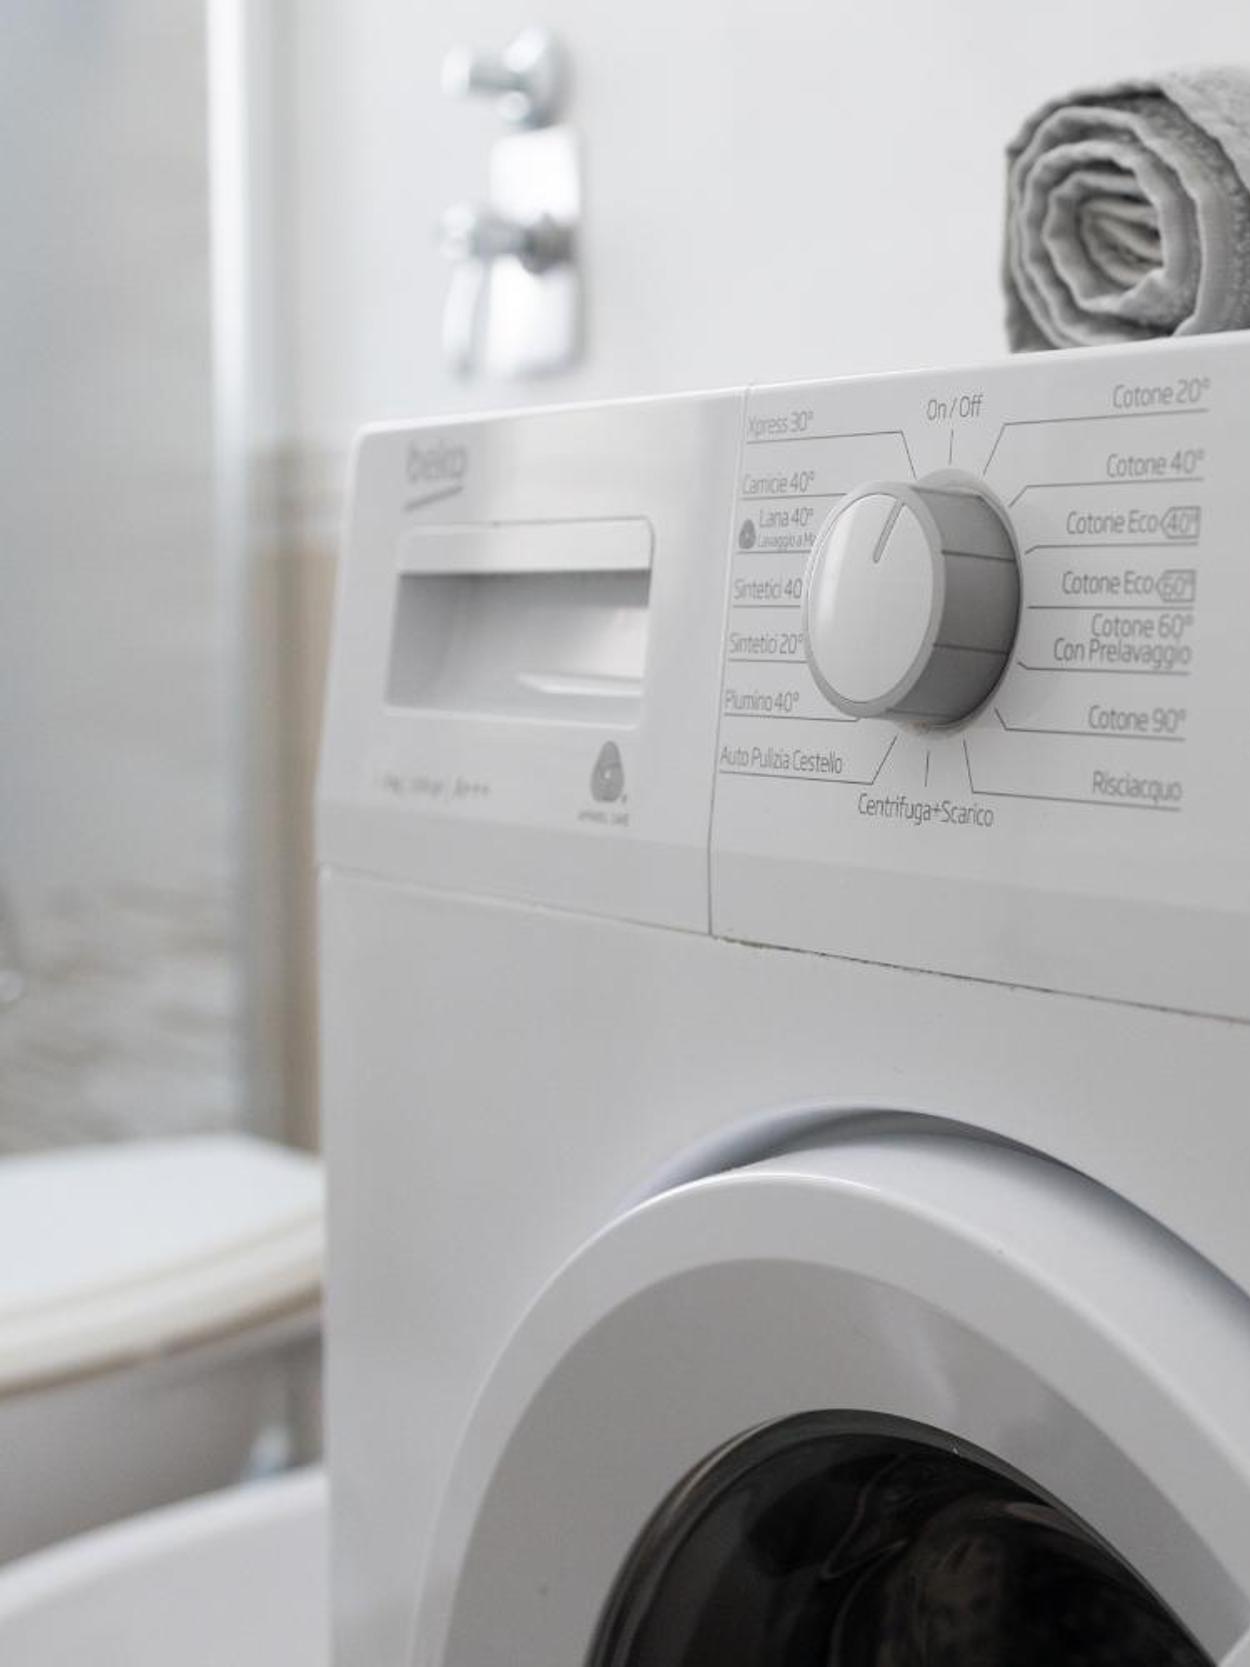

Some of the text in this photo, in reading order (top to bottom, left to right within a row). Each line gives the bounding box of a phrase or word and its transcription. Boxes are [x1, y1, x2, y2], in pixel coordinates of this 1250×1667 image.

[1112, 377, 1211, 409] Cotone 20°
[927, 398, 947, 420] On
[958, 394, 984, 418] Off
[749, 415, 788, 436] Xpress
[1106, 448, 1205, 477] Cotone 40°
[742, 474, 788, 494] Camicie
[758, 509, 789, 529] Lana
[1066, 510, 1126, 534] Cotone
[1127, 509, 1159, 534] Eco
[734, 576, 781, 600] Sintetici
[1062, 571, 1121, 594] Cotone
[1123, 571, 1154, 594] Eco
[1092, 613, 1194, 639] Cotone 60°
[729, 632, 777, 654] Sintetici
[1054, 637, 1192, 669] Con Prelavaggio
[724, 689, 773, 712] Plumino
[1088, 705, 1187, 733] Cotone 90°
[720, 746, 843, 774] Auto Pulizia Cestello
[1093, 770, 1183, 805] Risciacquo
[857, 792, 994, 827] Centrifuga+Scarico
